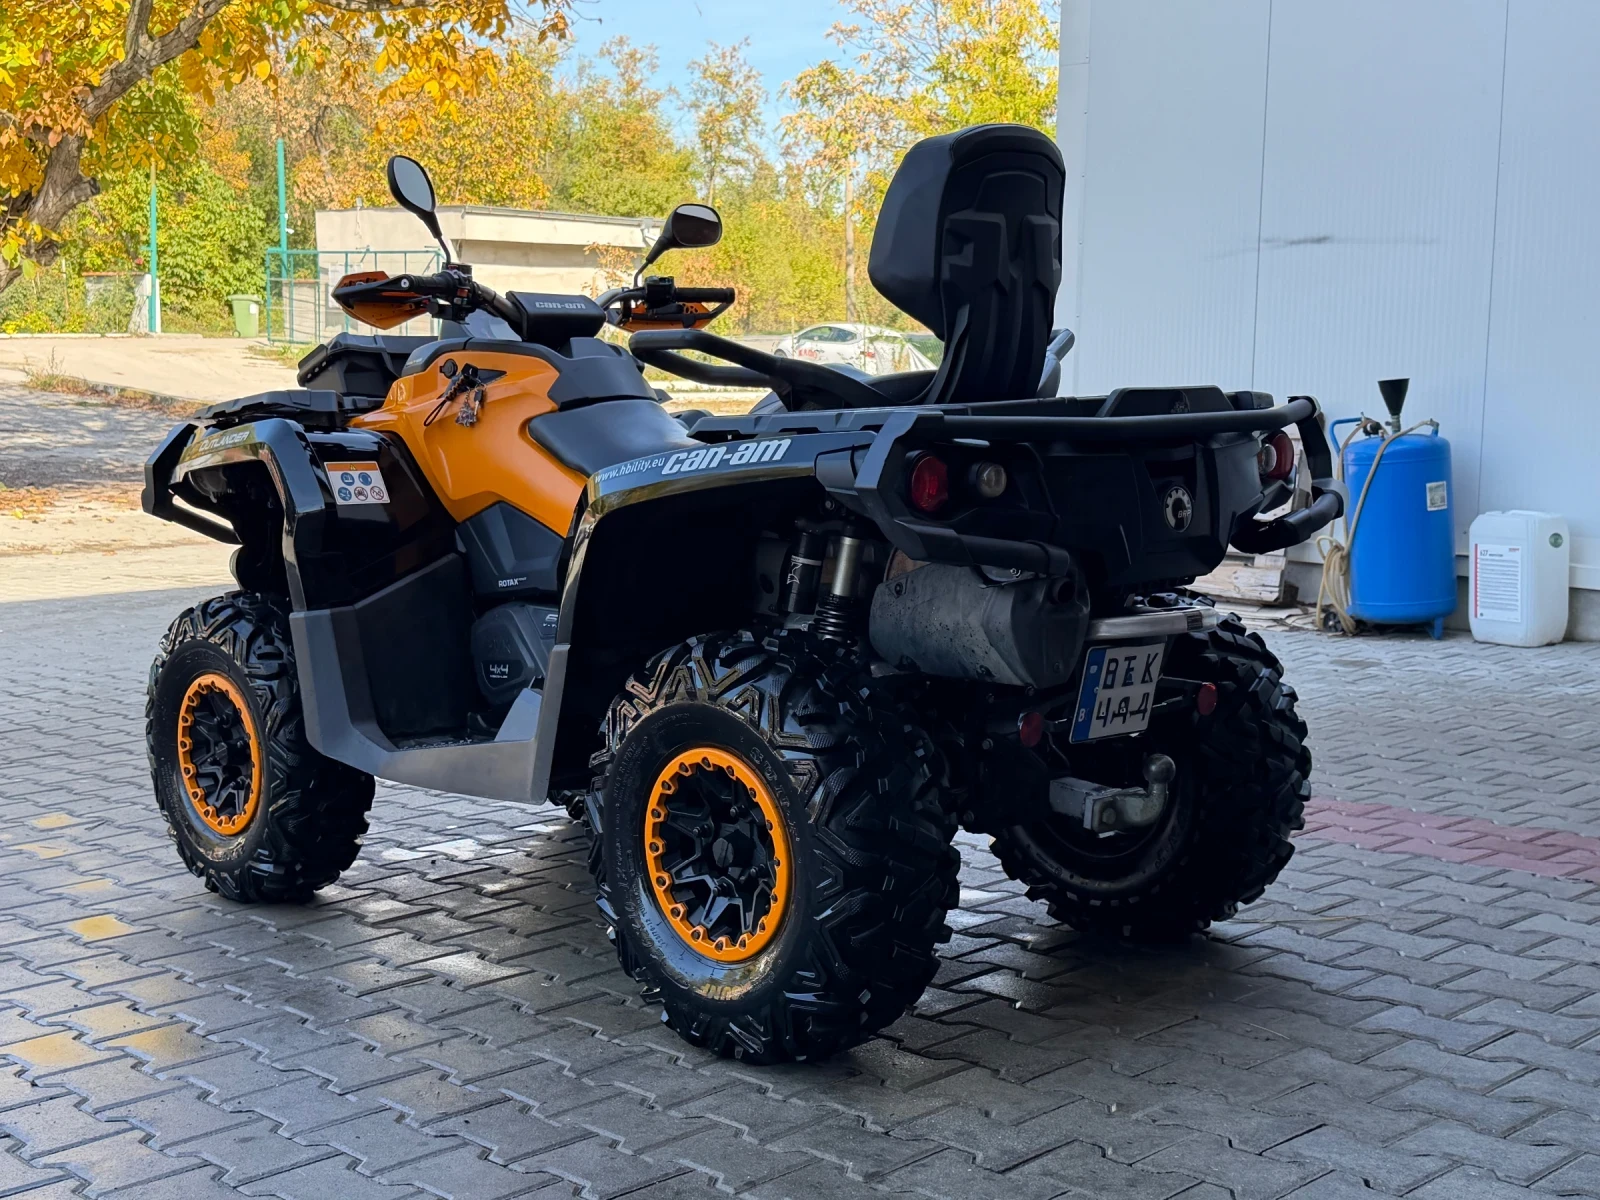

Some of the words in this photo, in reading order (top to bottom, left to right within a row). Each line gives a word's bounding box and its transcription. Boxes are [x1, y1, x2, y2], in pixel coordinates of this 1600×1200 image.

[535, 301, 586, 309] can-am
[199, 431, 251, 452] OUTLANDER
[595, 456, 665, 483] www.hbility.eu
[661, 438, 792, 476] can-am
[498, 578, 519, 588] ROTAX
